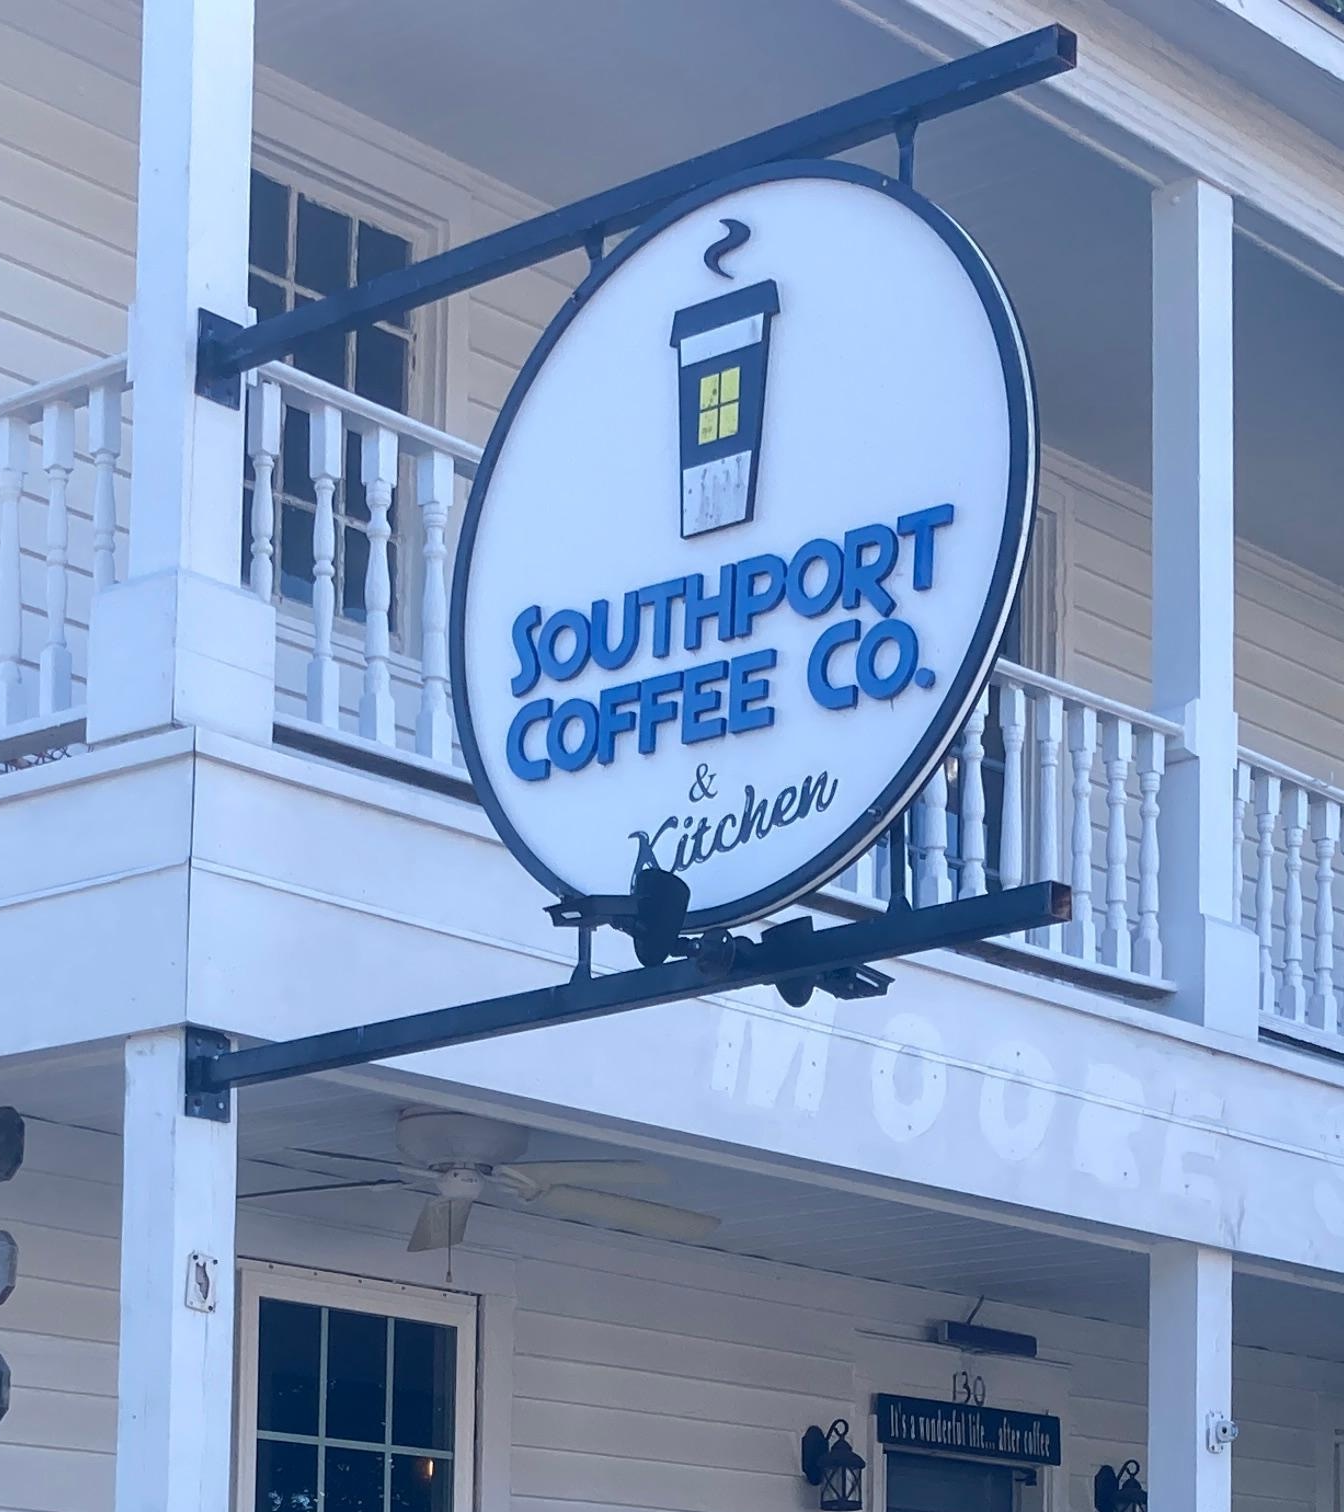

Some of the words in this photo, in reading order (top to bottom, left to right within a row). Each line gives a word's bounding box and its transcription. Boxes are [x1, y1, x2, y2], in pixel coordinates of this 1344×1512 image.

[510, 503, 954, 697] SOUTHPORT
[506, 648, 777, 782] COFFEE
[807, 618, 936, 710] CO.
[688, 762, 718, 802] &
[628, 769, 838, 888] Kitchen
[890, 1403, 907, 1439] It's
[910, 1415, 916, 1440] a
[919, 1409, 966, 1447] wonderful
[998, 1416, 1021, 1454] after
[1023, 1420, 1050, 1457] coffee
[952, 1371, 986, 1406] 130
